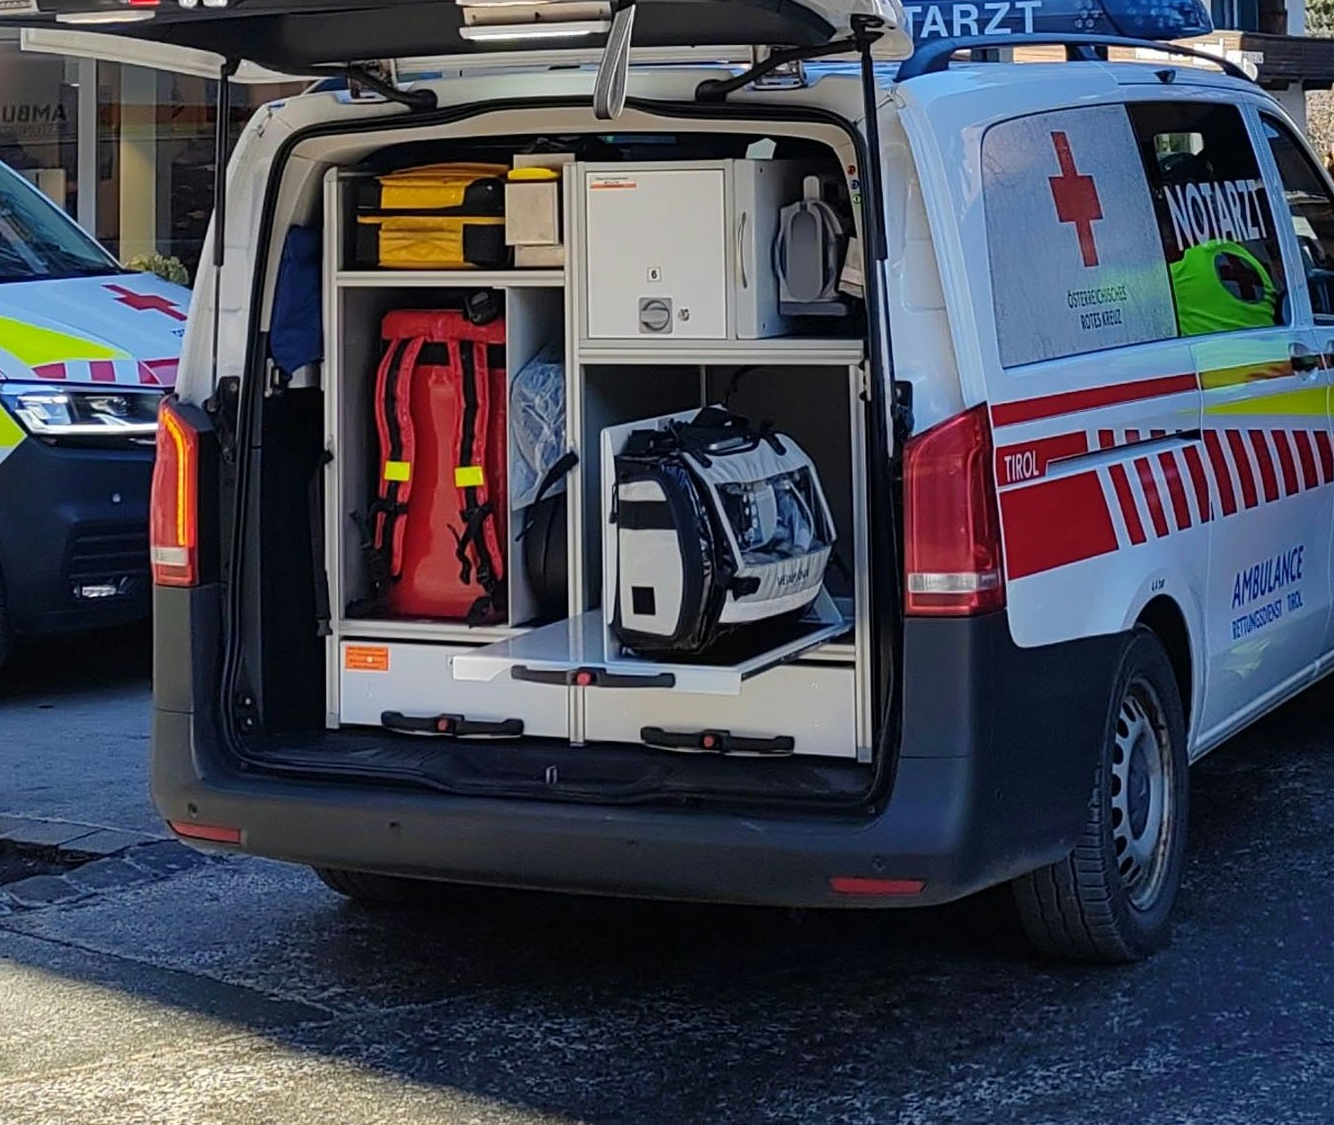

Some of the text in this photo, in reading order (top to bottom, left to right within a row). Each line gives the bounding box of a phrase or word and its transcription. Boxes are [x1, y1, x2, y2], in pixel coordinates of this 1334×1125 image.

[903, 0, 1043, 39] TARZT
[1164, 179, 1267, 251] NOTARZT
[1080, 308, 1123, 331] ROTES KREUZ
[1003, 450, 1040, 483] TIROL
[1231, 545, 1304, 610] AMBULANCE
